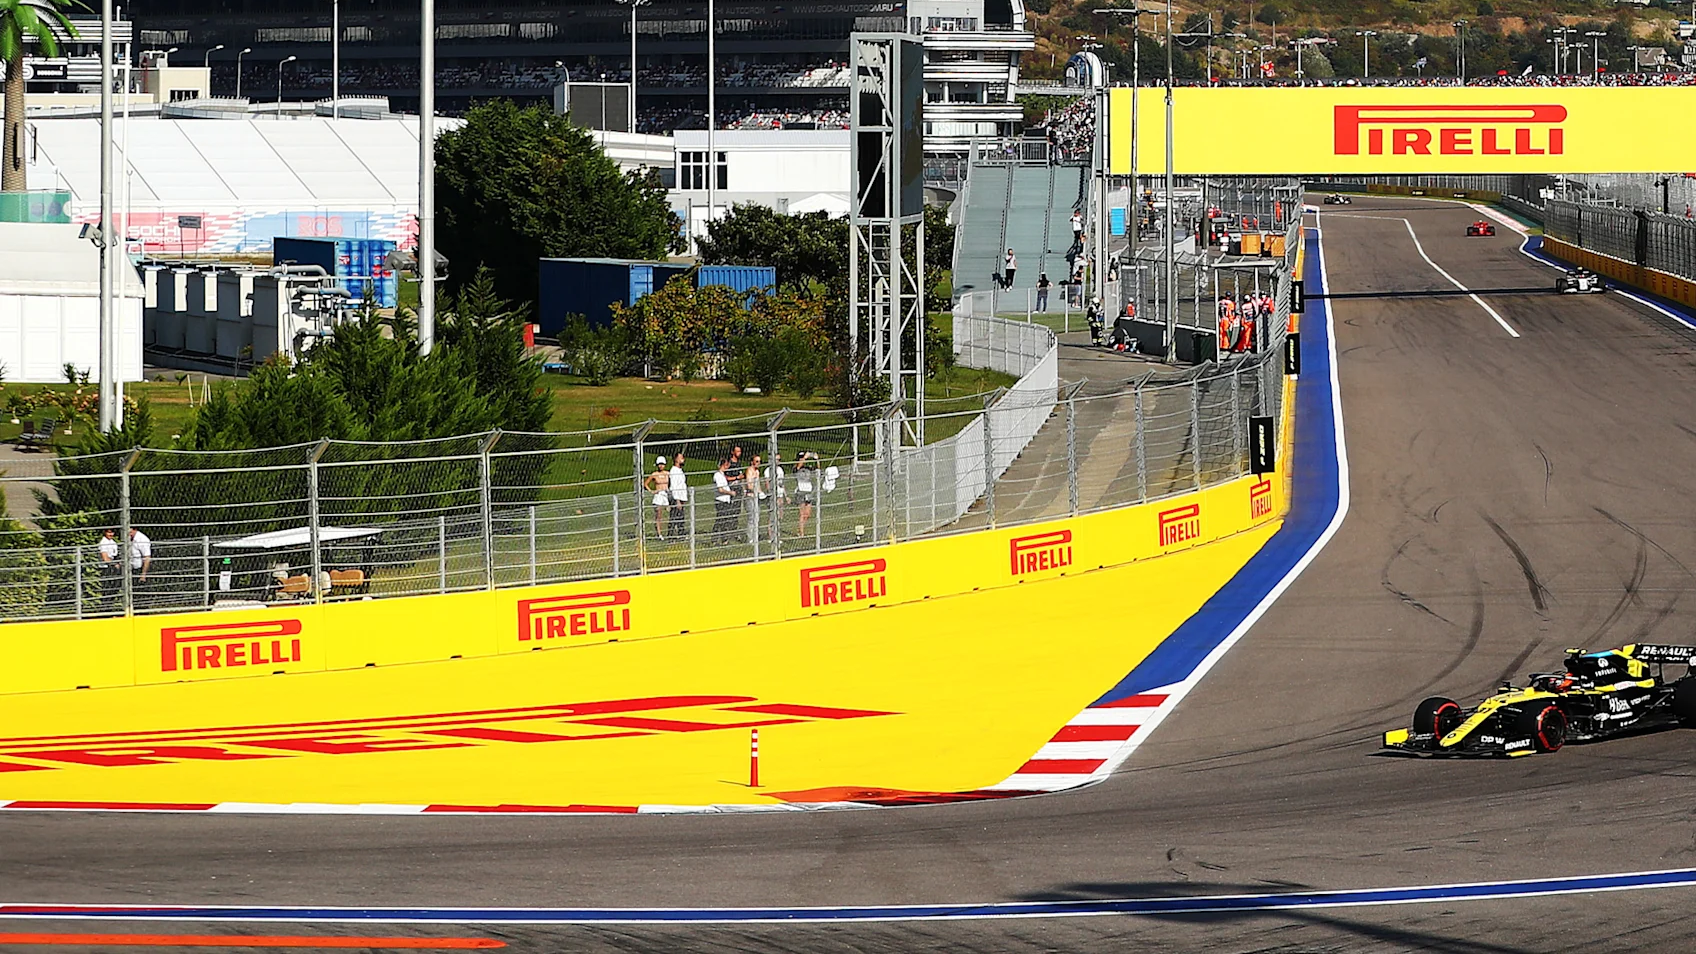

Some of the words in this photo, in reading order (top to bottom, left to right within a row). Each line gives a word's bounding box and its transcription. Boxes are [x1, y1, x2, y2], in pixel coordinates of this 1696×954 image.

[703, 7, 724, 15] SCHI
[1334, 105, 1567, 155] PIRELLI
[128, 226, 180, 236] SOCHI
[1250, 479, 1272, 520] PIRELLI
[1158, 504, 1200, 546] PIRELLI
[1011, 530, 1072, 576] PIRELLI
[801, 558, 886, 607] PIRELLI
[518, 590, 630, 641] PIRELLI
[161, 619, 302, 671] PIRELLI
[1641, 646, 1694, 656] RENAULT
